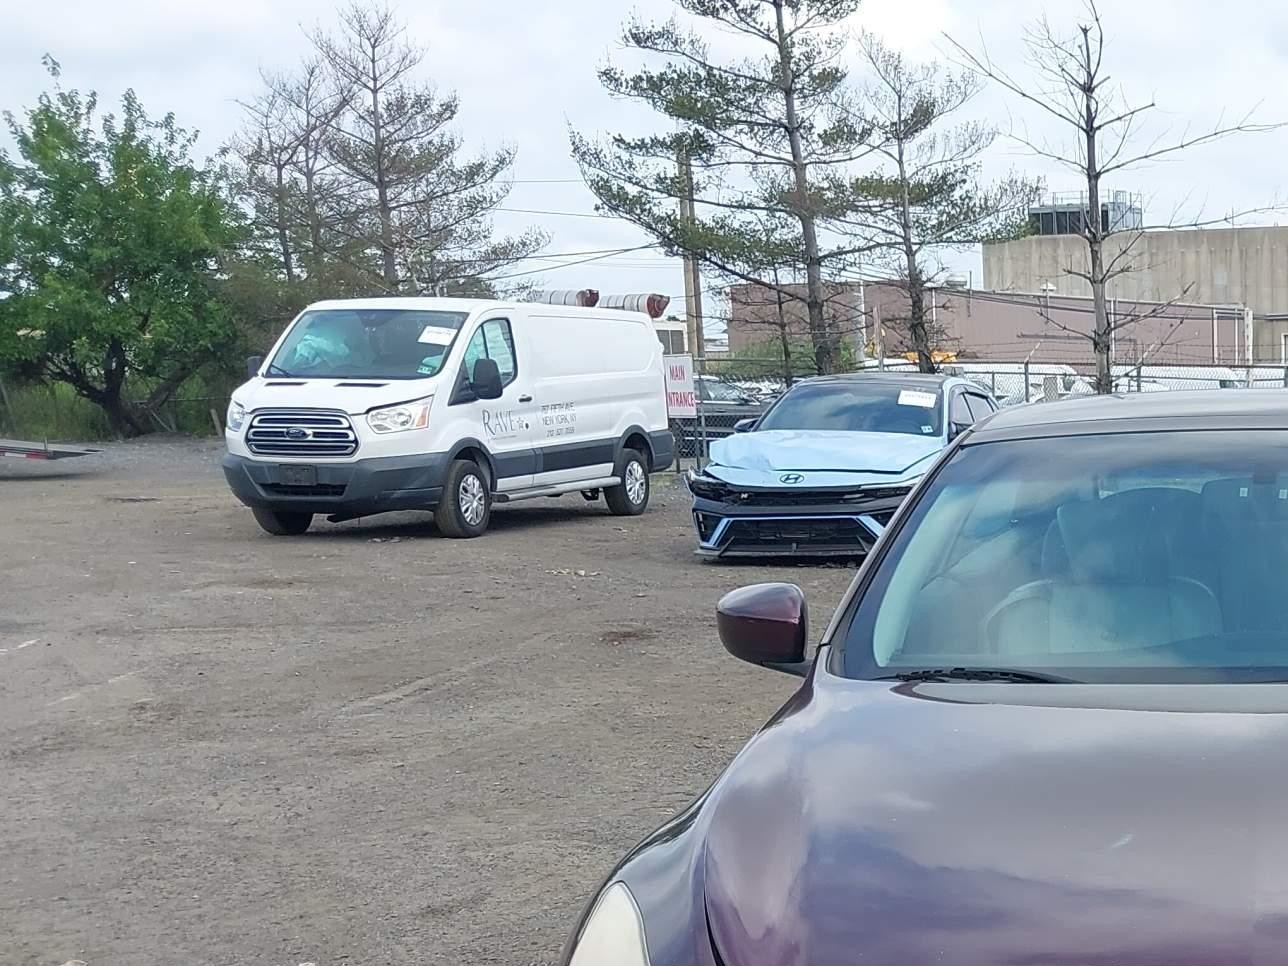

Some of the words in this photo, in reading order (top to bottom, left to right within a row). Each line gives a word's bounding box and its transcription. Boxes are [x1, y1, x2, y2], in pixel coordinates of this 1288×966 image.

[670, 365, 685, 380] MAIN
[668, 391, 694, 407] NTRANCE
[482, 409, 516, 435] RAVE
[542, 416, 554, 426] NEW
